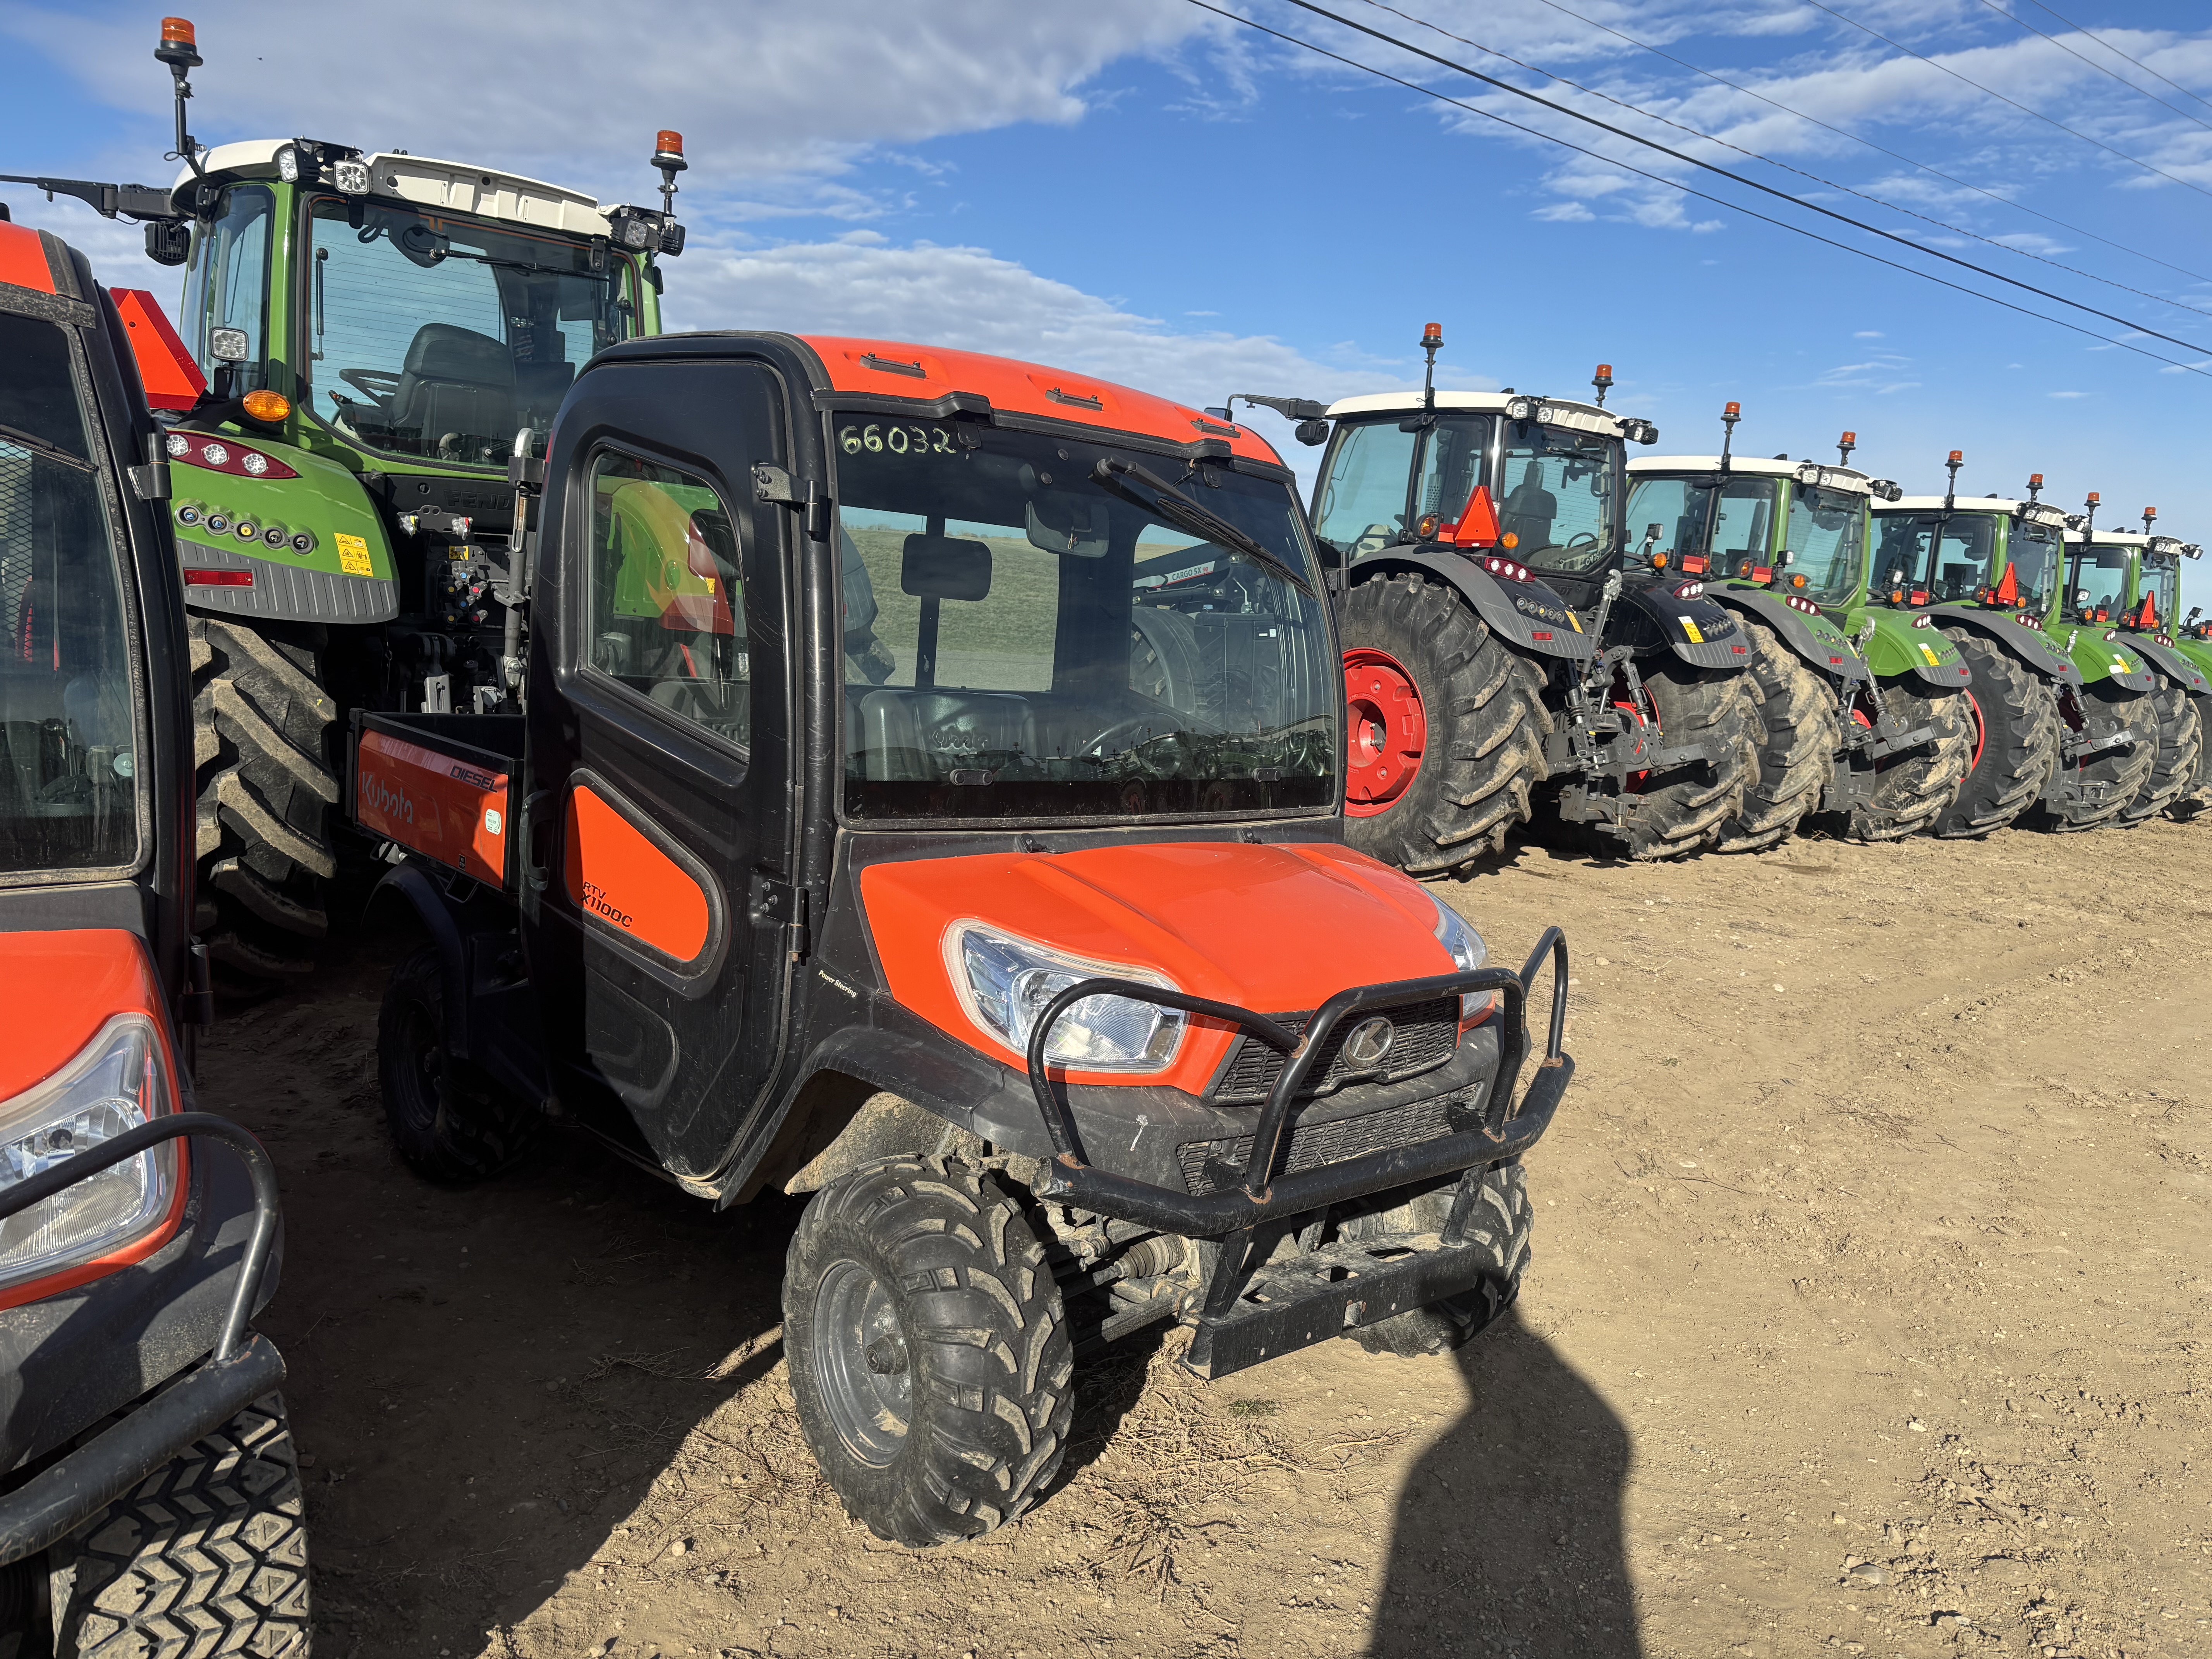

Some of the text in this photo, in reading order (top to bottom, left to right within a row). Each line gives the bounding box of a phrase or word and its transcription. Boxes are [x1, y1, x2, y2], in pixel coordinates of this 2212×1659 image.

[839, 424, 957, 455] 66032
[444, 490, 515, 511] FEND
[1172, 569, 1192, 580] CARGO
[1194, 567, 1201, 575] 5X
[450, 766, 498, 793] DIESEL
[362, 771, 413, 824] Kubota
[583, 881, 606, 899] RTV
[580, 891, 632, 927] X1100C
[818, 970, 857, 998] Power Steering
